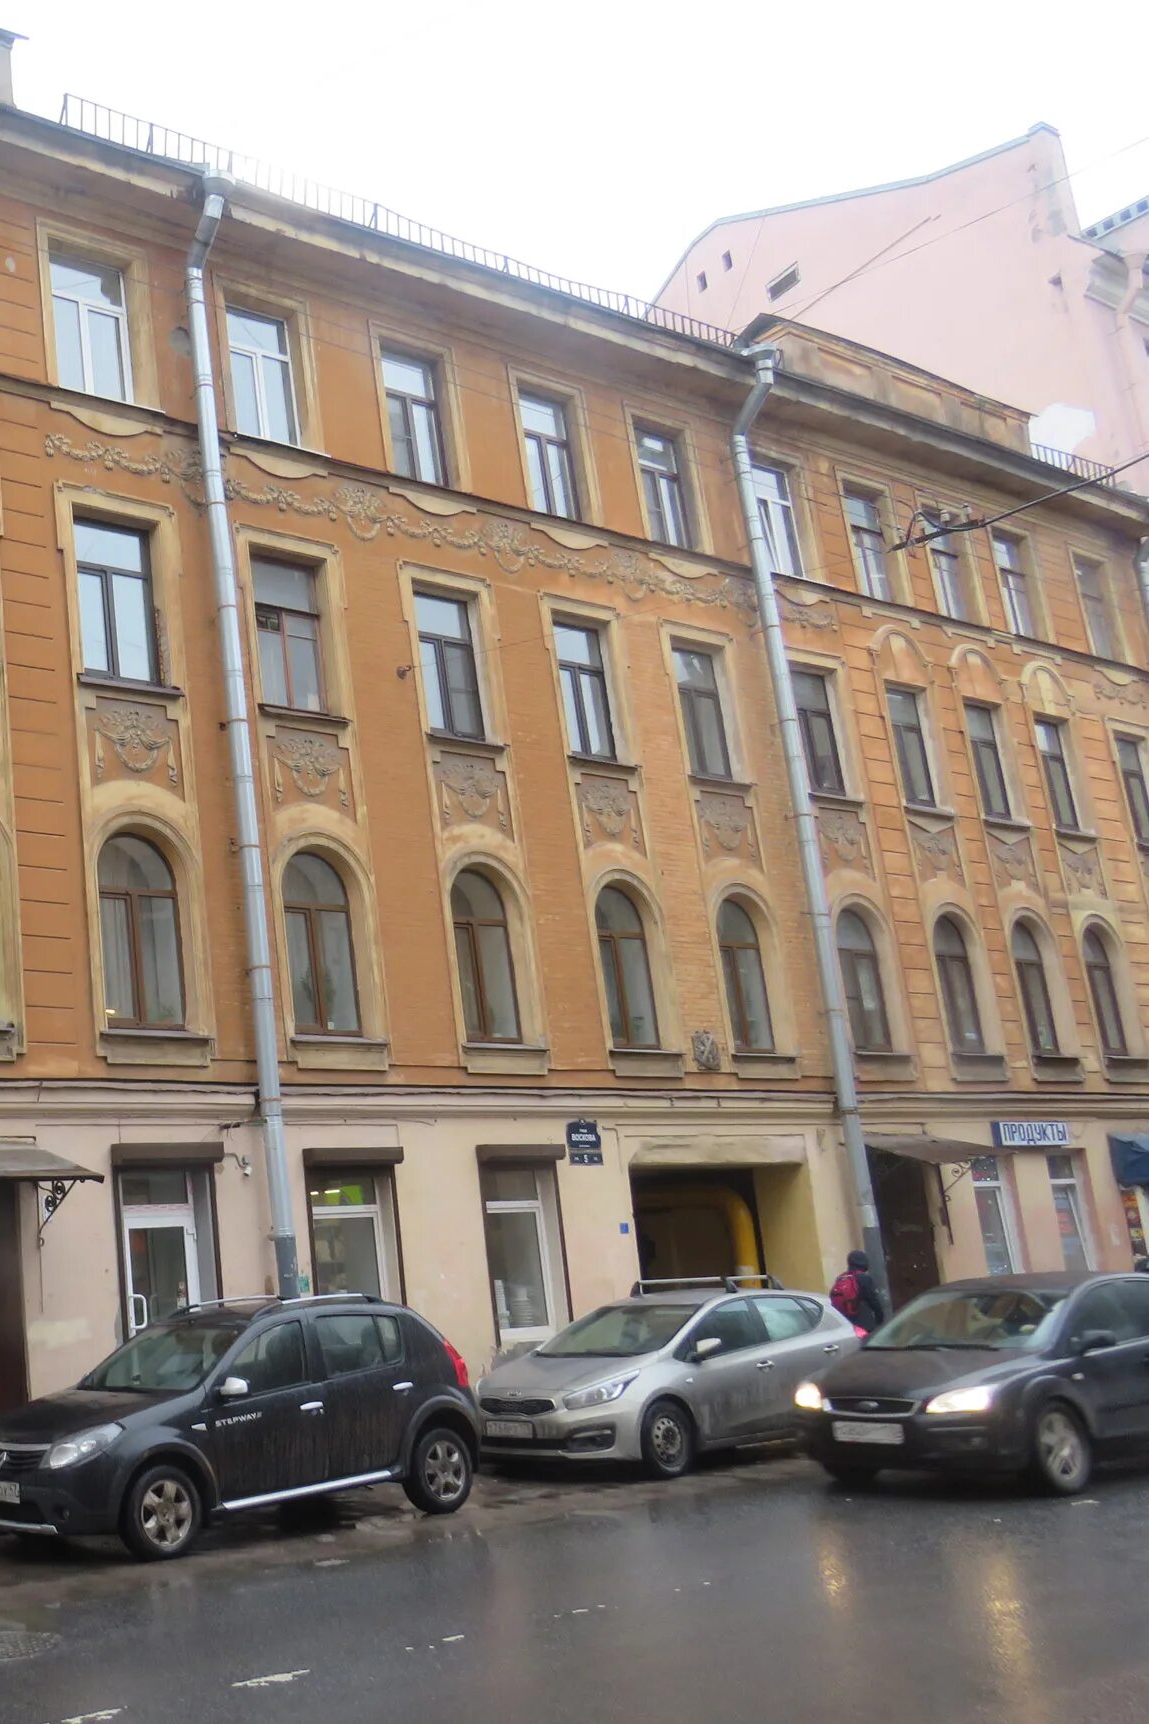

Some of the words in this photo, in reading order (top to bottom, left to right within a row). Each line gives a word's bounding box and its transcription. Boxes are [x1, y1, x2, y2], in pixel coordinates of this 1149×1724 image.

[571, 1133, 596, 1142] ВОСКОВА
[1002, 1123, 1067, 1144] ПРОДУКТЫ
[215, 1412, 257, 1428] STEPWAY
